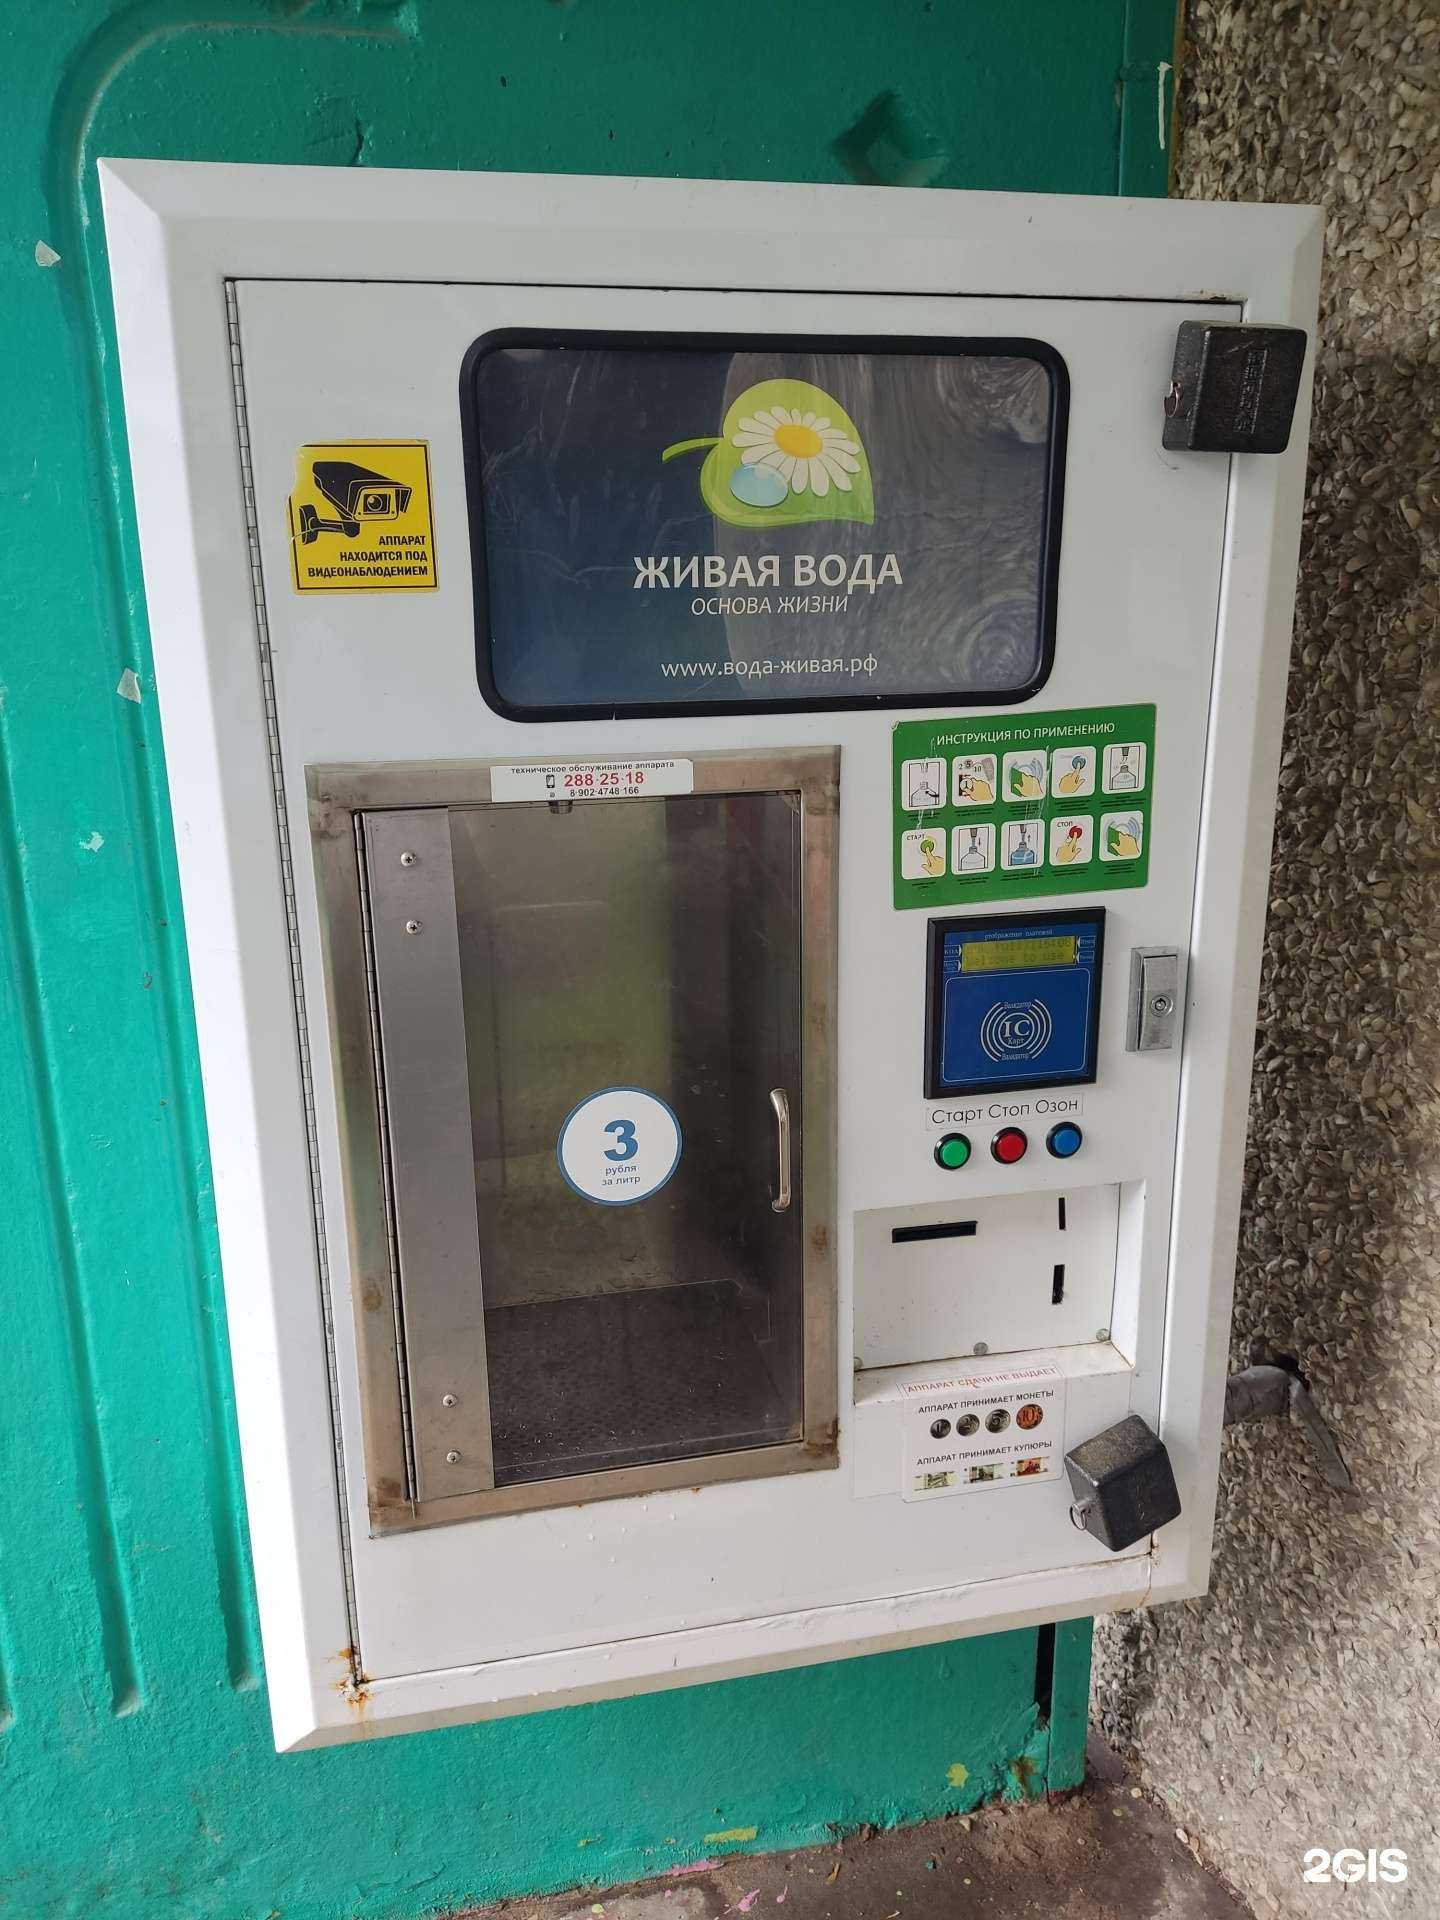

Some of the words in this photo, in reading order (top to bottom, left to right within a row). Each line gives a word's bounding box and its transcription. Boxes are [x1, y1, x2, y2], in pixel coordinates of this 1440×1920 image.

[379, 536, 425, 545] АППАРАТ
[340, 551, 402, 562] НАХОДИТСЯ
[405, 551, 427, 561] ПОД
[308, 566, 428, 578] ВИДЕОНАБЛЮДЕНИЕМ
[633, 556, 780, 589] ЖИВАЯ
[794, 553, 902, 593] ВОДА
[692, 596, 771, 616] ОСНОВА
[778, 595, 848, 614] ЖИЗНИ
[662, 654, 878, 680] www.вода-живая.рф
[937, 730, 1011, 745] ИНСТРУКЦИЯ
[1015, 728, 1030, 739] ПО
[1034, 722, 1115, 738] ПРИМЕНЕНИЮ
[512, 766, 567, 774] техническое
[569, 762, 633, 773] обслуживание
[635, 761, 674, 769] аппарата
[1003, 1020, 1030, 1037] IC
[932, 1108, 983, 1127] Старт
[989, 1104, 1030, 1118] Стоп
[1035, 1098, 1078, 1113] Озон
[604, 1120, 638, 1161] 3
[606, 1165, 637, 1175] рубля
[616, 1176, 640, 1185] литр
[907, 1380, 954, 1394] АППАРАТ
[958, 1375, 994, 1388] СДАЧИ
[996, 1373, 1009, 1383] НЕ
[1012, 1367, 1057, 1382] ВЫДАЕТ
[919, 1402, 958, 1414] АППАРАТ
[960, 1395, 1014, 1409] ПРИНИМАЕТ
[1016, 1390, 1054, 1402] МОНЕТЫ
[917, 1454, 956, 1466] АППАРАТ
[959, 1447, 1012, 1461] ПРИНИМАЕТ
[1014, 1440, 1052, 1453] КУПЮРЫ
